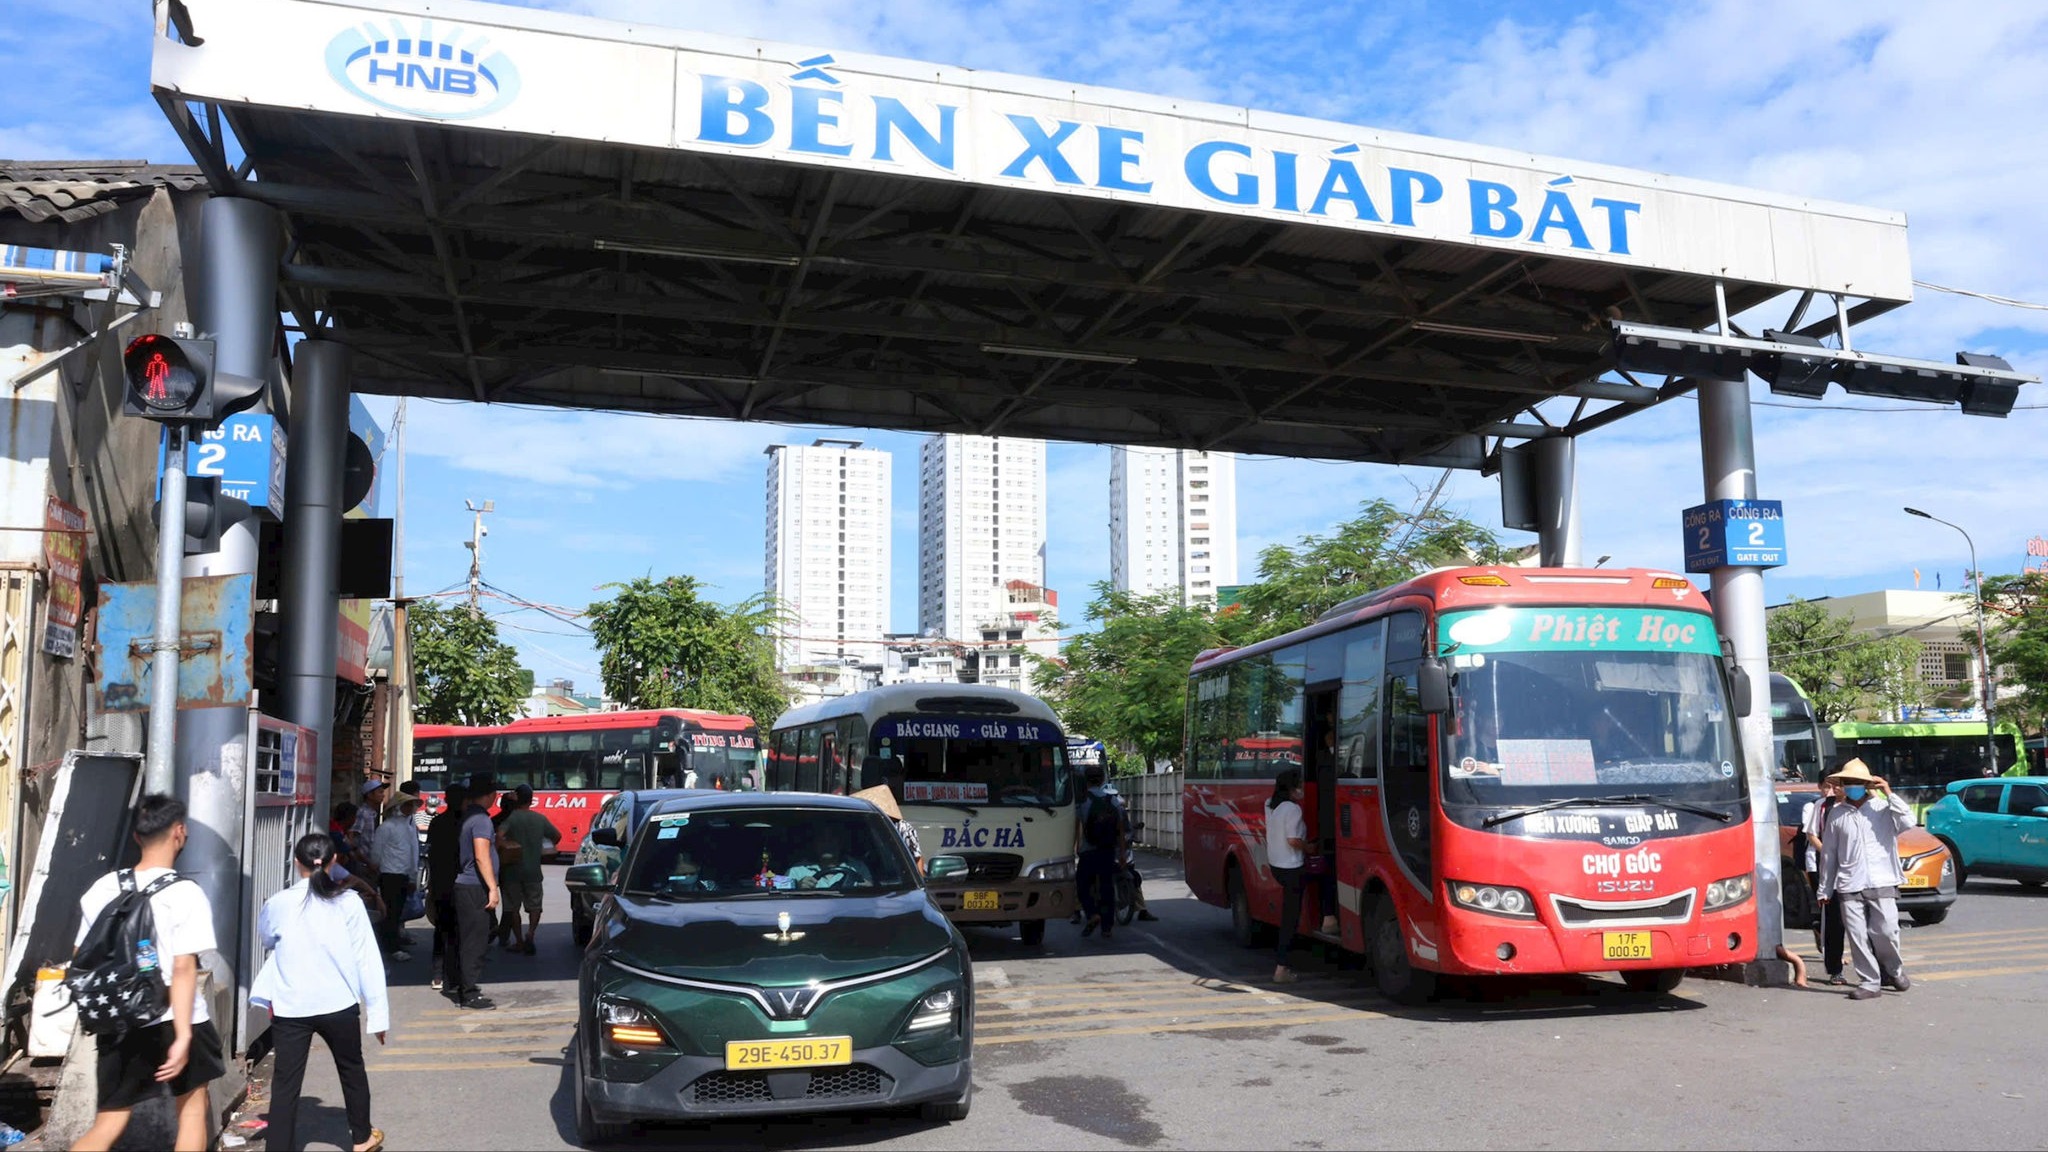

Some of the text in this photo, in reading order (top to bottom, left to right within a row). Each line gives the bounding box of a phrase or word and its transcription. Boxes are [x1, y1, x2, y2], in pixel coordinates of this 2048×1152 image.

[368, 59, 478, 96] HNB
[694, 53, 1642, 255] BẾN XE GIÁP BÁT
[232, 423, 262, 442] RA
[196, 443, 227, 476] 2
[1708, 509, 1721, 522] RA
[1762, 507, 1779, 520] RA
[1698, 527, 1710, 549] 2
[1748, 522, 1765, 545] 2
[1736, 553, 1779, 562] GATE OUT
[1529, 614, 1697, 648] Phiệt Học
[922, 723, 960, 738] GIANG
[980, 721, 1008, 739] GIÁP
[1017, 722, 1039, 740] BÁT
[729, 735, 755, 749] LÂM
[545, 794, 587, 809] LÂM
[1655, 810, 1679, 831] BÁT
[941, 819, 1025, 848] BẮC HÀ
[1603, 836, 1640, 845] SAMCO
[1582, 847, 1662, 877] CHỢ GỐC
[1598, 880, 1654, 892] ISUZU
[1618, 933, 1637, 944] 17F
[1608, 946, 1646, 957] 000.97
[738, 1043, 840, 1064] 29E-450.37
